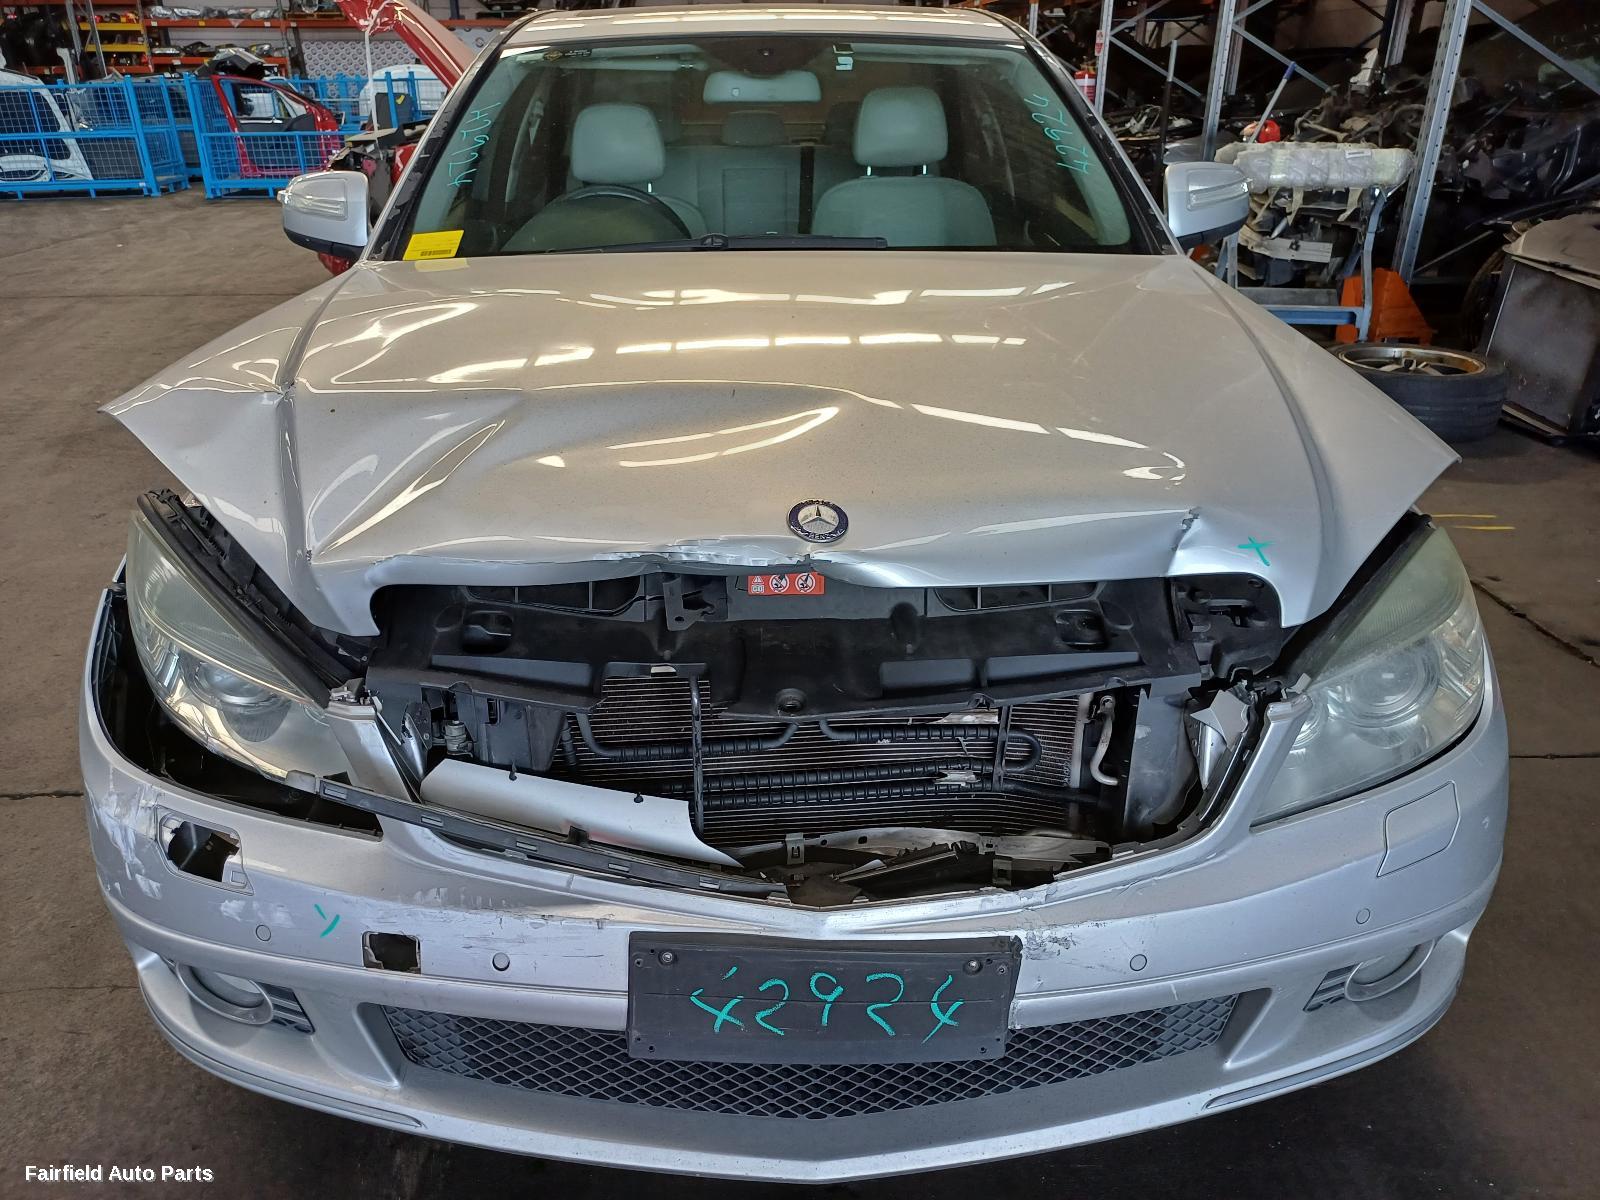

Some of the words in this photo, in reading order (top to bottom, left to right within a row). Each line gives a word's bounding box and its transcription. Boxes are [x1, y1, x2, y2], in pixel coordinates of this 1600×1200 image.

[447, 102, 502, 187] 42924
[1023, 94, 1096, 175] 42924
[690, 967, 964, 1040] 42924
